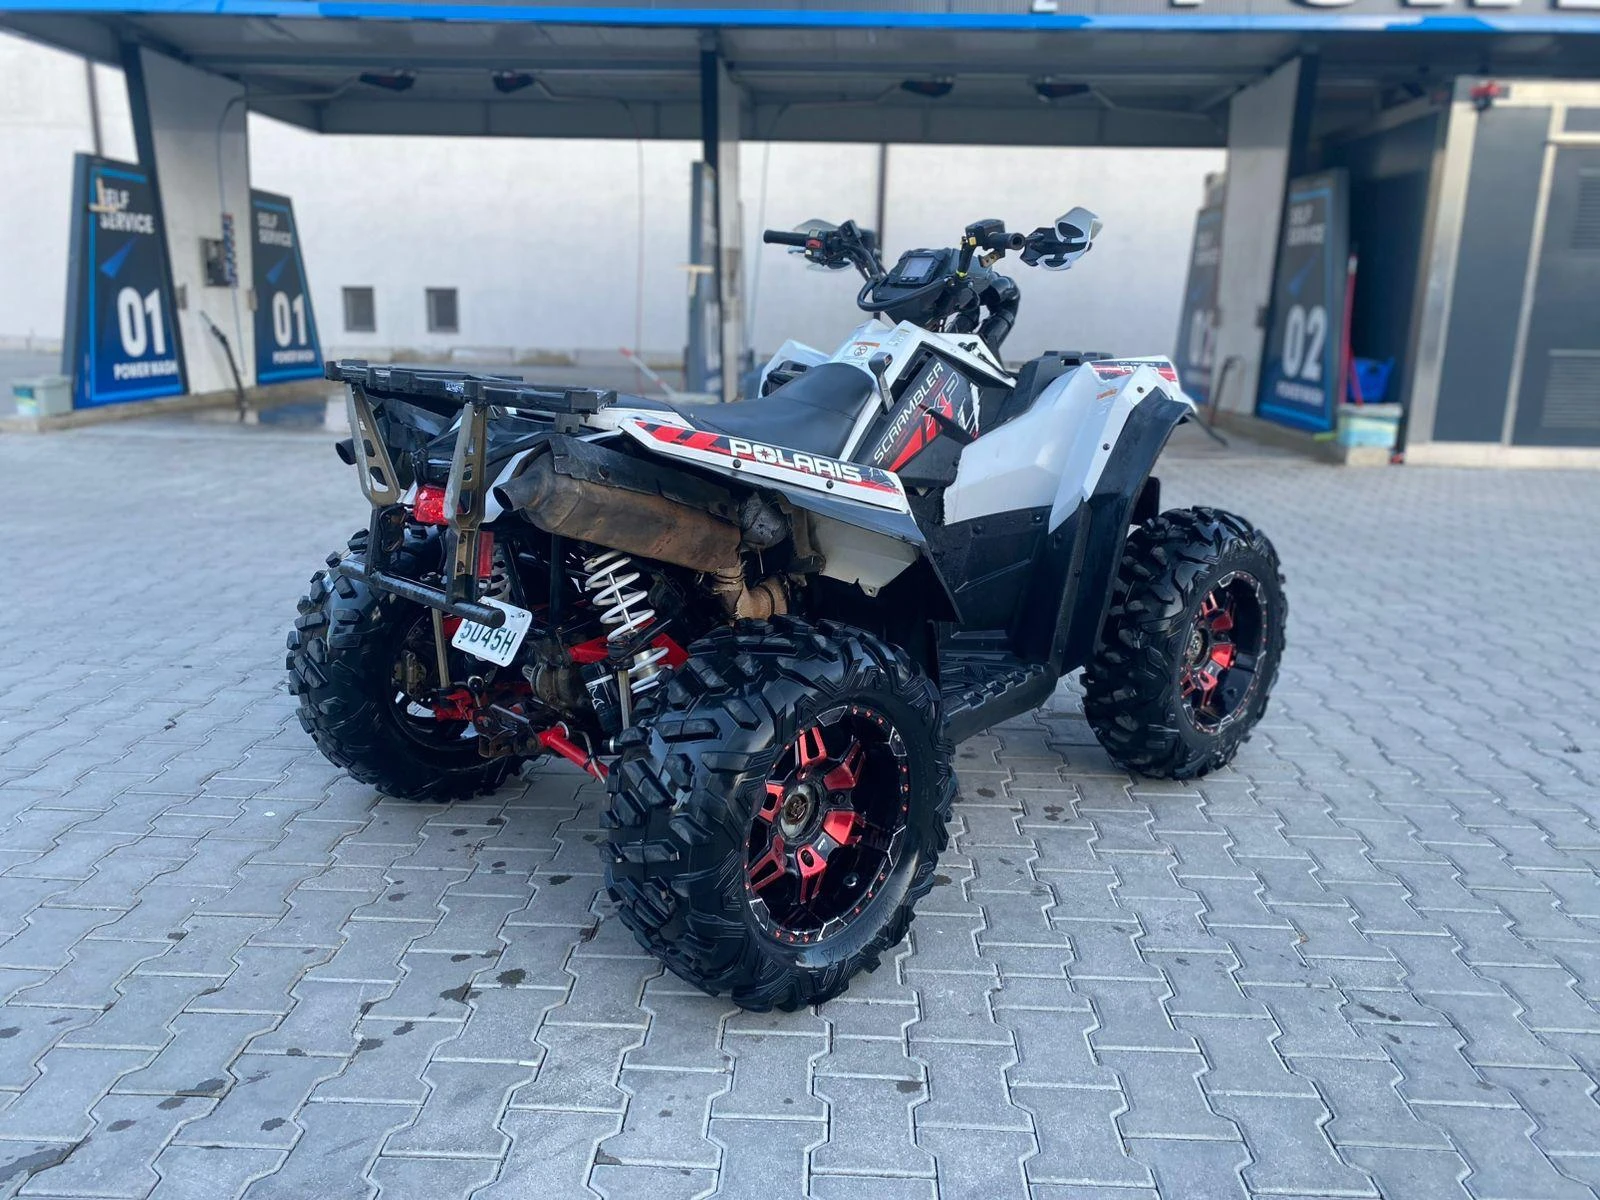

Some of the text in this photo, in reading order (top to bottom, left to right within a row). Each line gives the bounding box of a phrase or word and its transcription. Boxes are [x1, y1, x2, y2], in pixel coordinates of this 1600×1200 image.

[100, 211, 154, 234] SERVICE
[117, 286, 166, 357] 01
[272, 290, 307, 347] 01
[1282, 304, 1328, 381] 02
[113, 361, 151, 381] POWER
[874, 361, 944, 465] SCRAMBLER
[922, 371, 959, 433] XP
[729, 438, 862, 483] POLARIS
